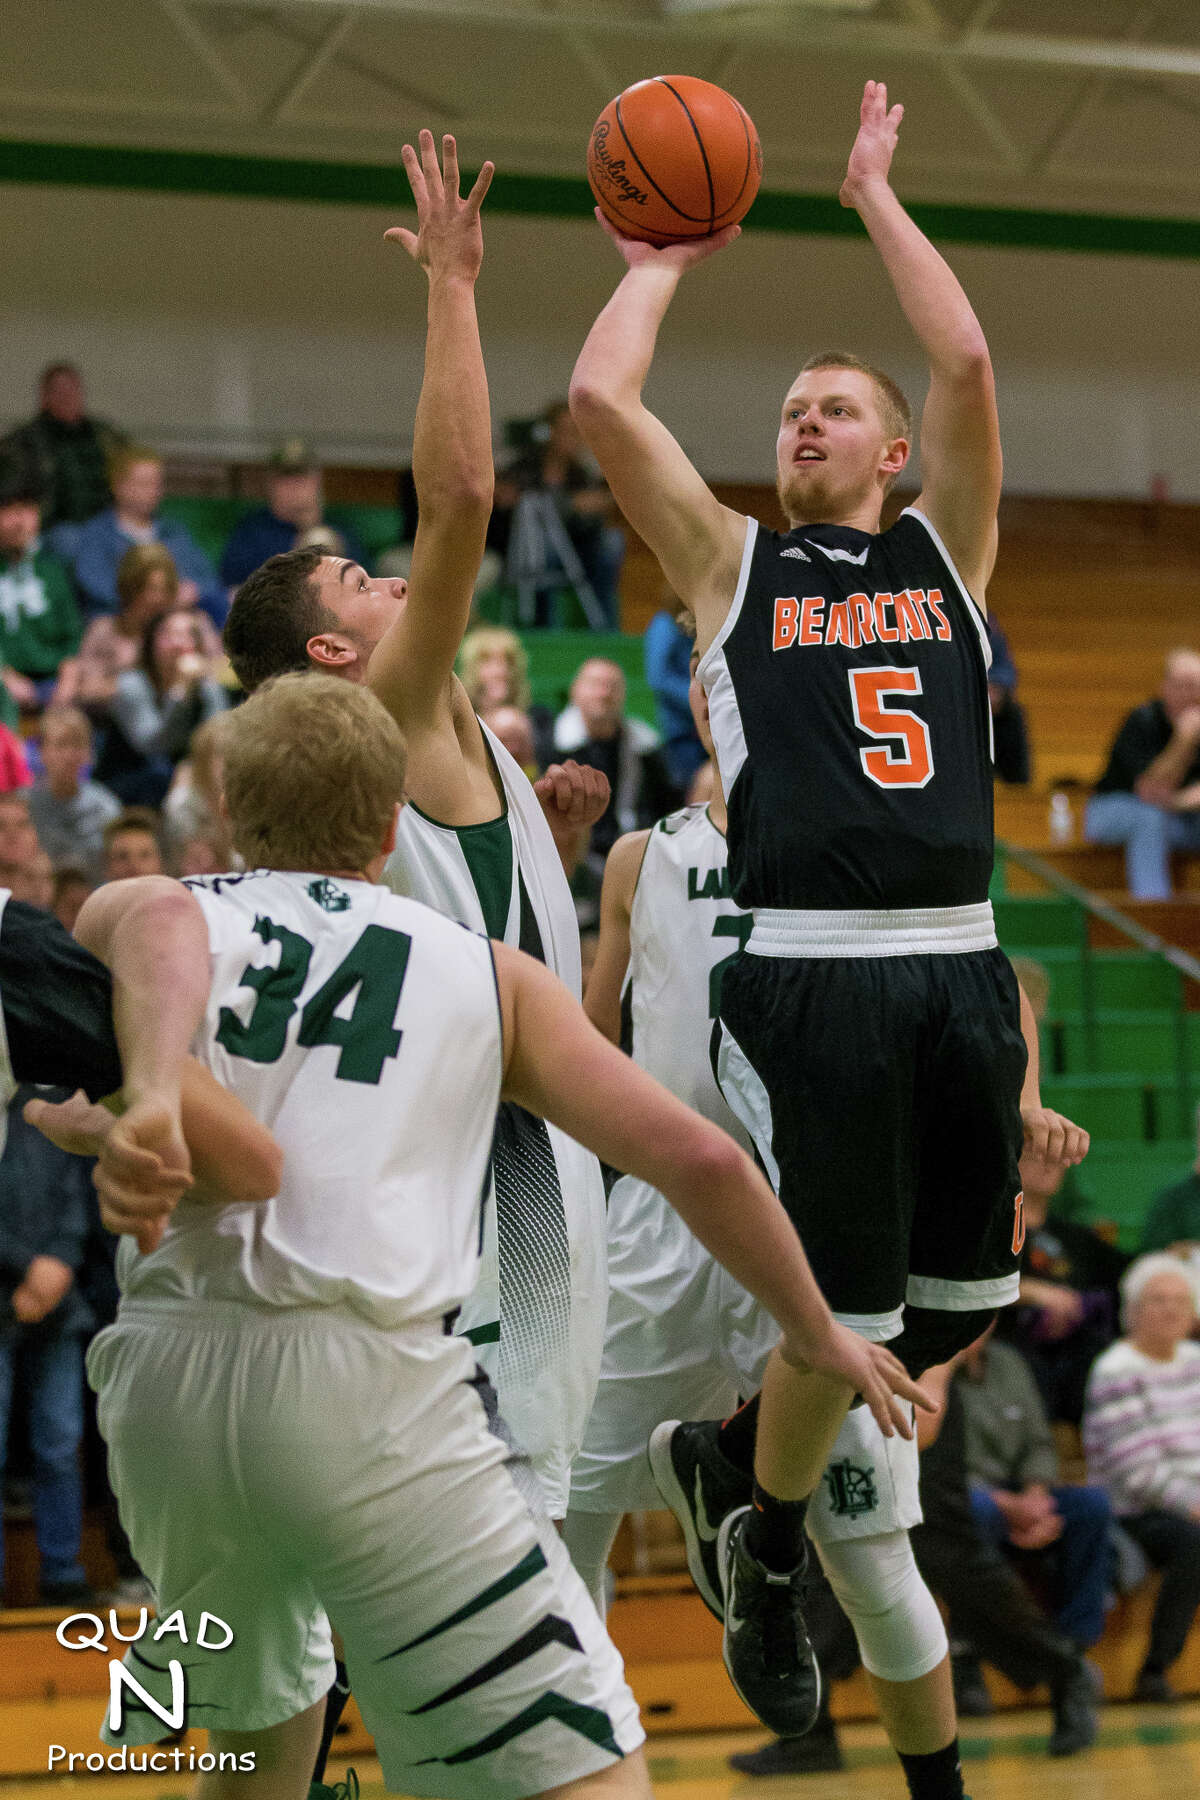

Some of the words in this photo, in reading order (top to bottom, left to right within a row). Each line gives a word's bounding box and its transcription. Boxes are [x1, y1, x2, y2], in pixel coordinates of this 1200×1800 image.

[592, 120, 649, 206] Rawlings
[773, 588, 951, 651] BEARCATS
[848, 666, 935, 789] 5
[215, 912, 413, 1086] 34
